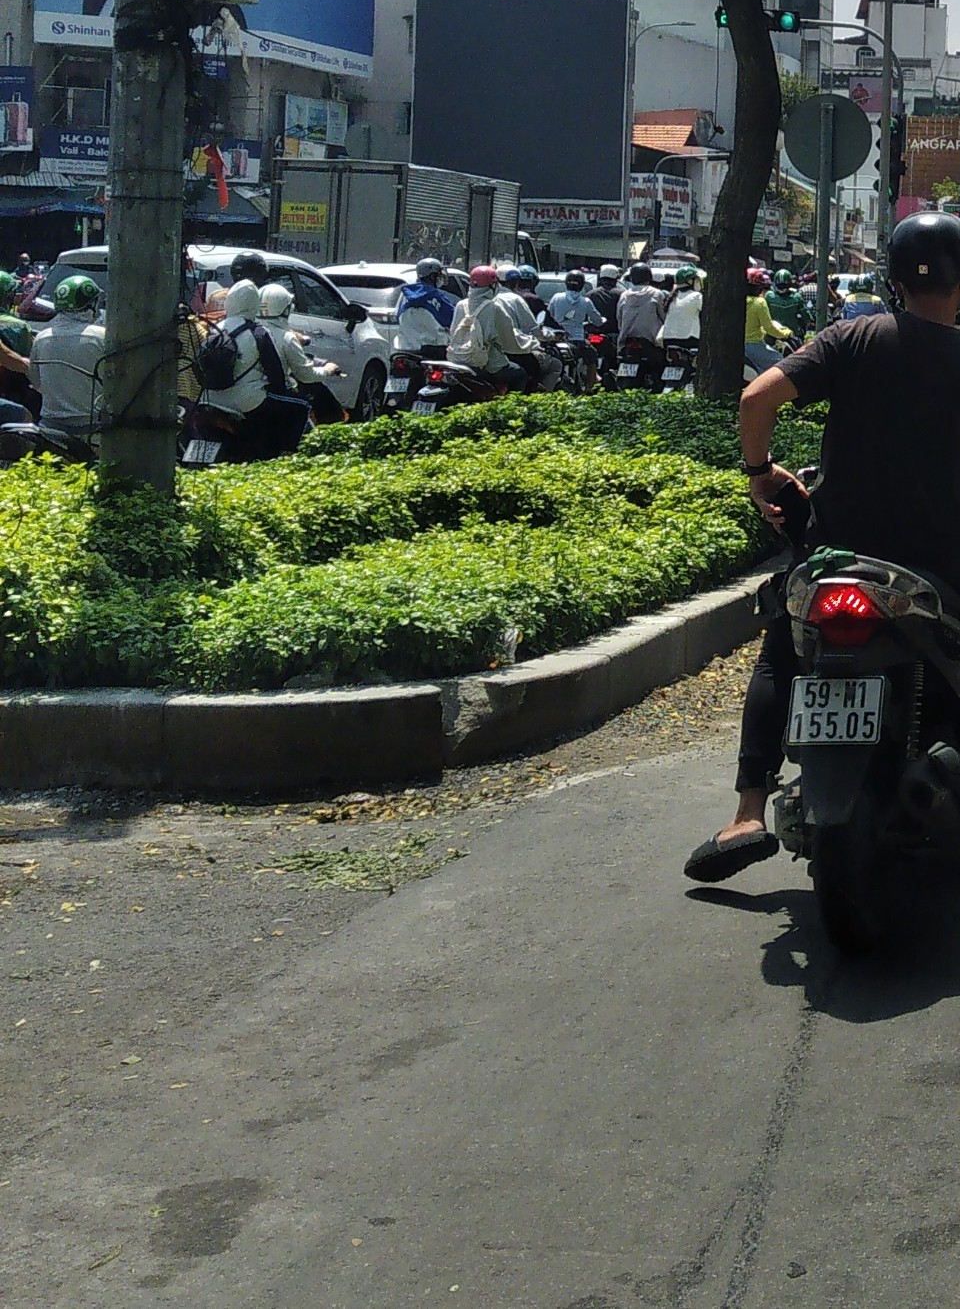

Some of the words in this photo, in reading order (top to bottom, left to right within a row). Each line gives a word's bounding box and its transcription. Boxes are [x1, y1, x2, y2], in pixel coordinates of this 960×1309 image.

[67, 24, 111, 37] Shinhan
[60, 134, 93, 145] H.K.D
[794, 711, 876, 740] 155.05
